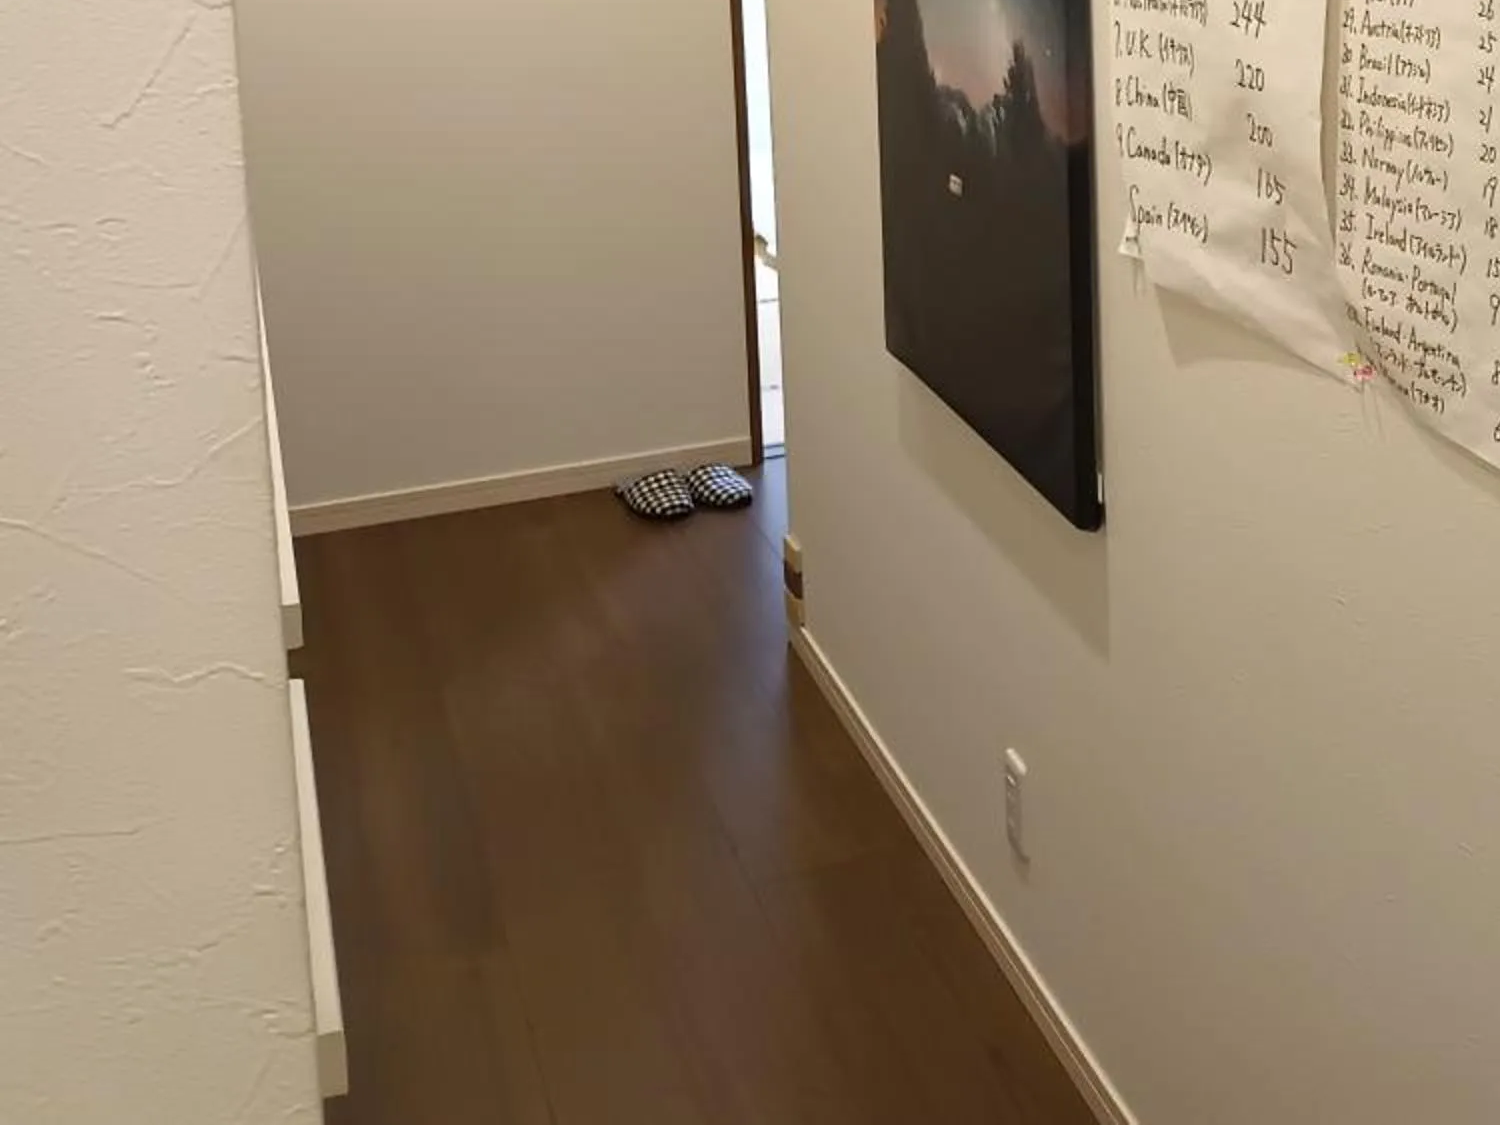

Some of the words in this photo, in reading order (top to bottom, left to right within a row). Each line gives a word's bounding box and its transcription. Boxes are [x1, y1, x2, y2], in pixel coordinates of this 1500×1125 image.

[1229, 0, 1267, 38] 244
[1476, 29, 1499, 55] 25
[1234, 58, 1266, 93] 220
[1475, 63, 1496, 95] 24
[1246, 112, 1275, 150] 200
[1478, 103, 1494, 135] 21
[1479, 142, 1498, 164] 20
[1256, 167, 1286, 206] 165
[1481, 175, 1499, 209] 19
[1483, 215, 1499, 240] 18
[1260, 226, 1298, 275] 155
